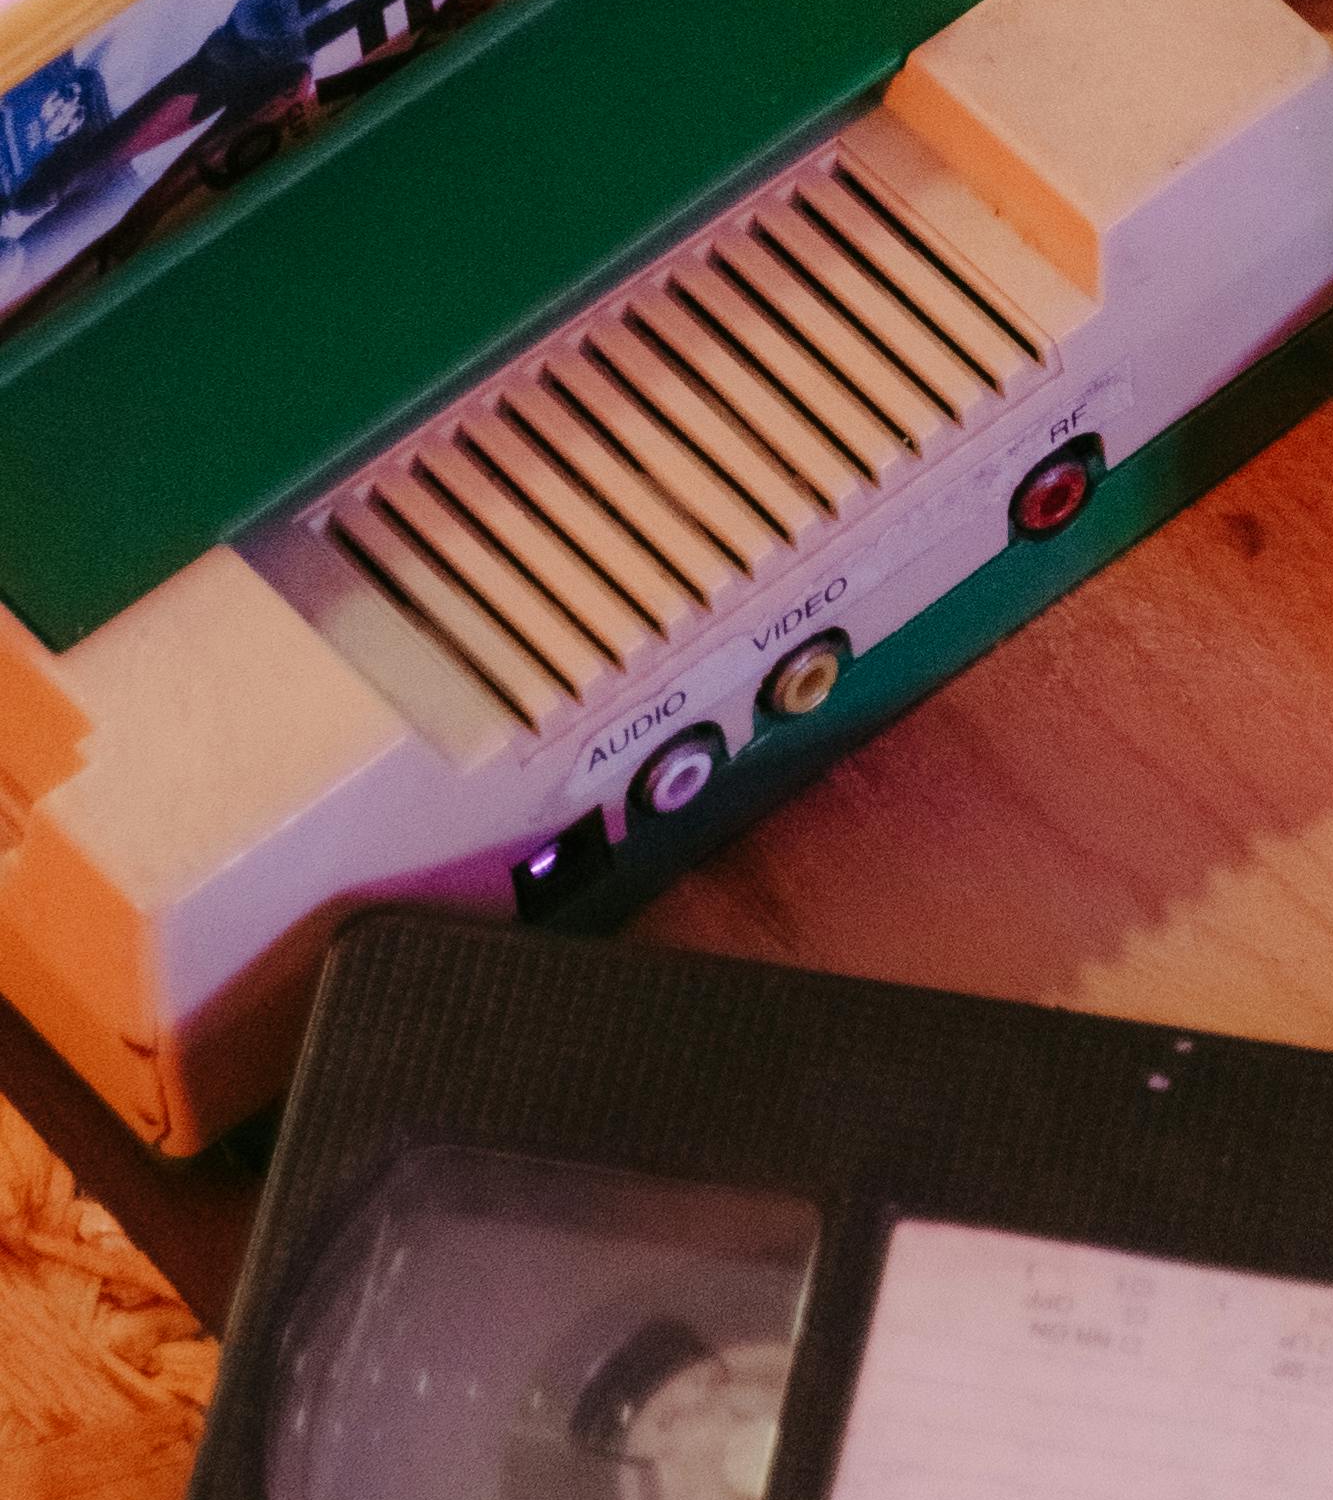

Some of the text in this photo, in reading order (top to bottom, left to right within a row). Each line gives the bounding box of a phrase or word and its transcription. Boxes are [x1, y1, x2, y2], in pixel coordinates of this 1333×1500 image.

[1049, 402, 1088, 444] RF
[750, 574, 849, 655] VIDEO
[585, 689, 689, 774] AUDIO
